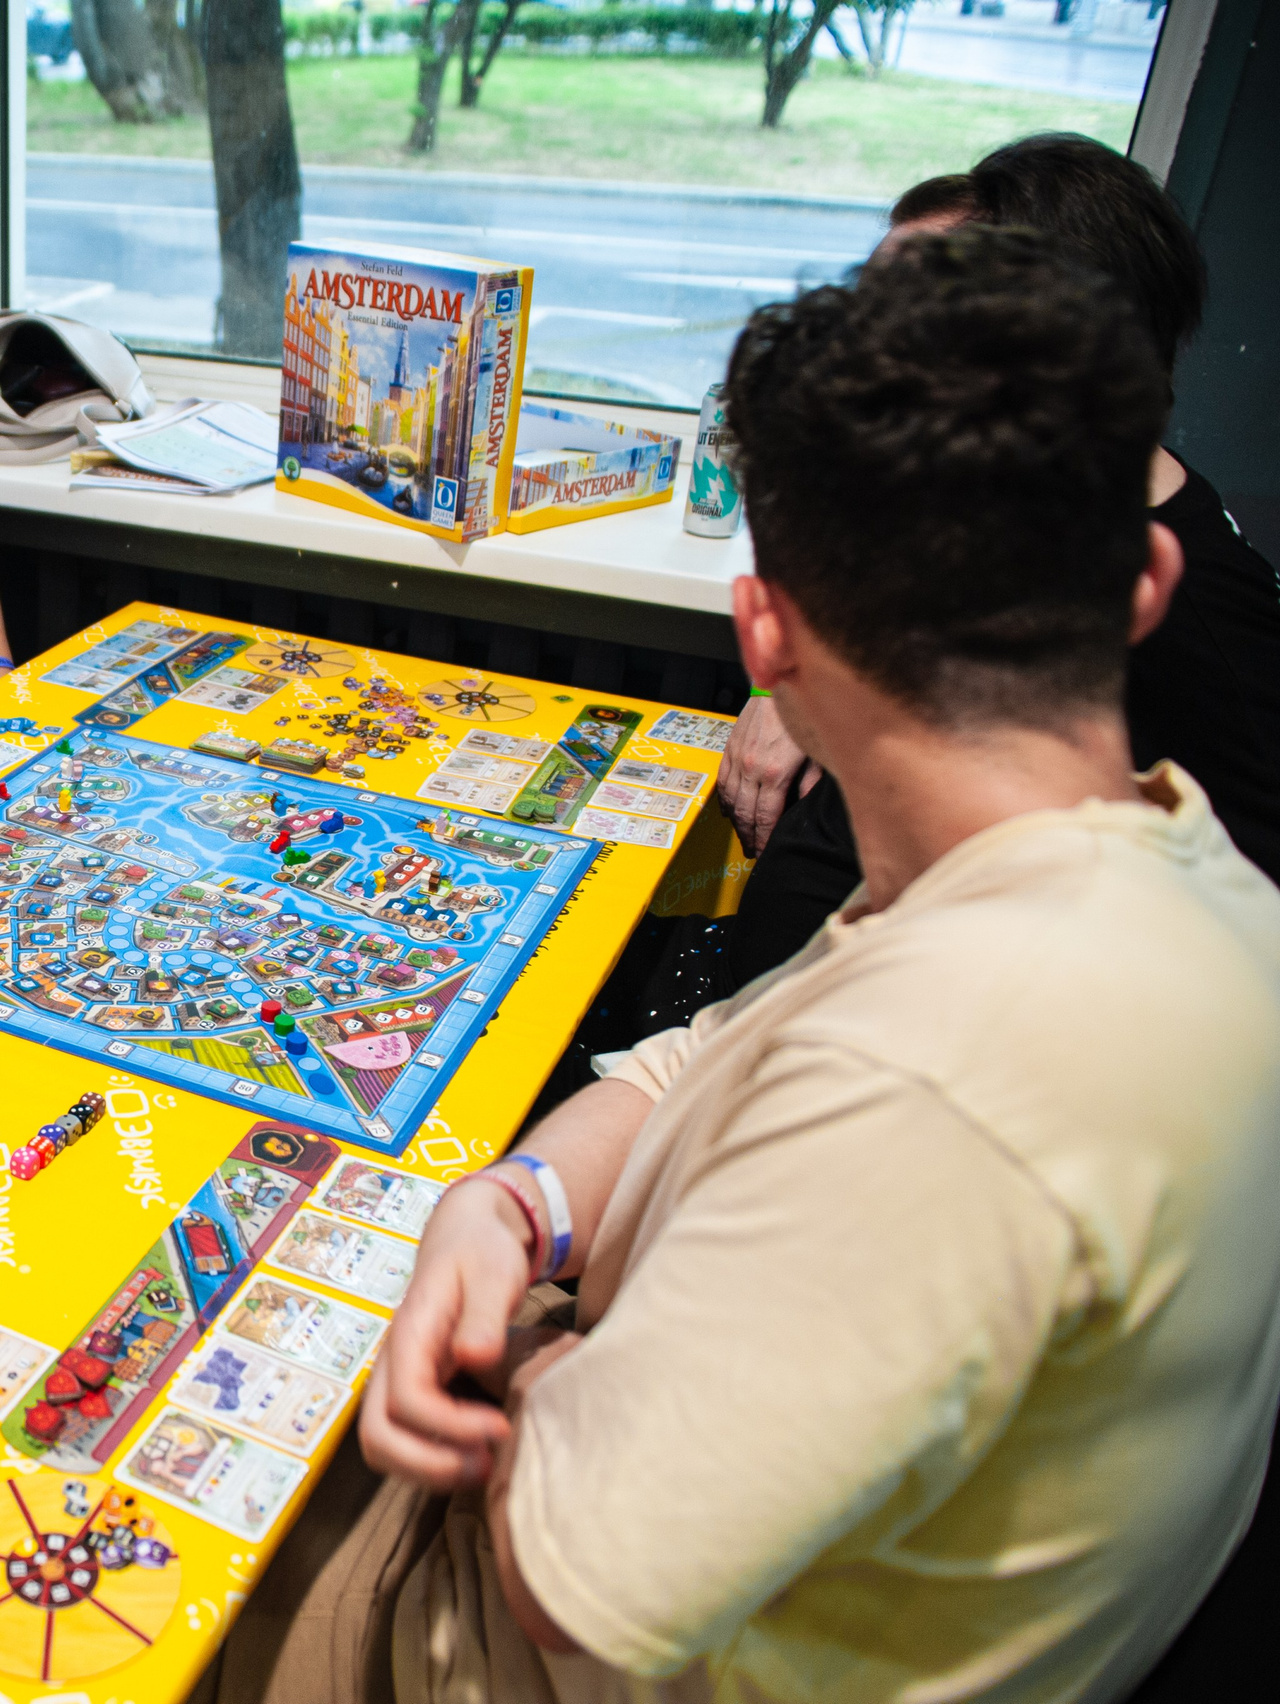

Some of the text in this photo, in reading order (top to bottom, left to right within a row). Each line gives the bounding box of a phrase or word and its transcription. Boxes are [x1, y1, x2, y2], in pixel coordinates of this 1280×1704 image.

[361, 261, 403, 277] Stefan Feld
[303, 267, 465, 324] AMSTERDAM
[347, 311, 409, 331] Essential Edition
[485, 326, 513, 469] AMSTERDAM
[552, 470, 637, 504] AMSTERDAM
[350, 1021, 359, 1029] 3
[378, 1013, 388, 1022] 5
[112, 1044, 125, 1052] 85
[238, 1084, 252, 1092] 80
[371, 1126, 386, 1135] 75
[114, 1119, 166, 1210] Эврикус
